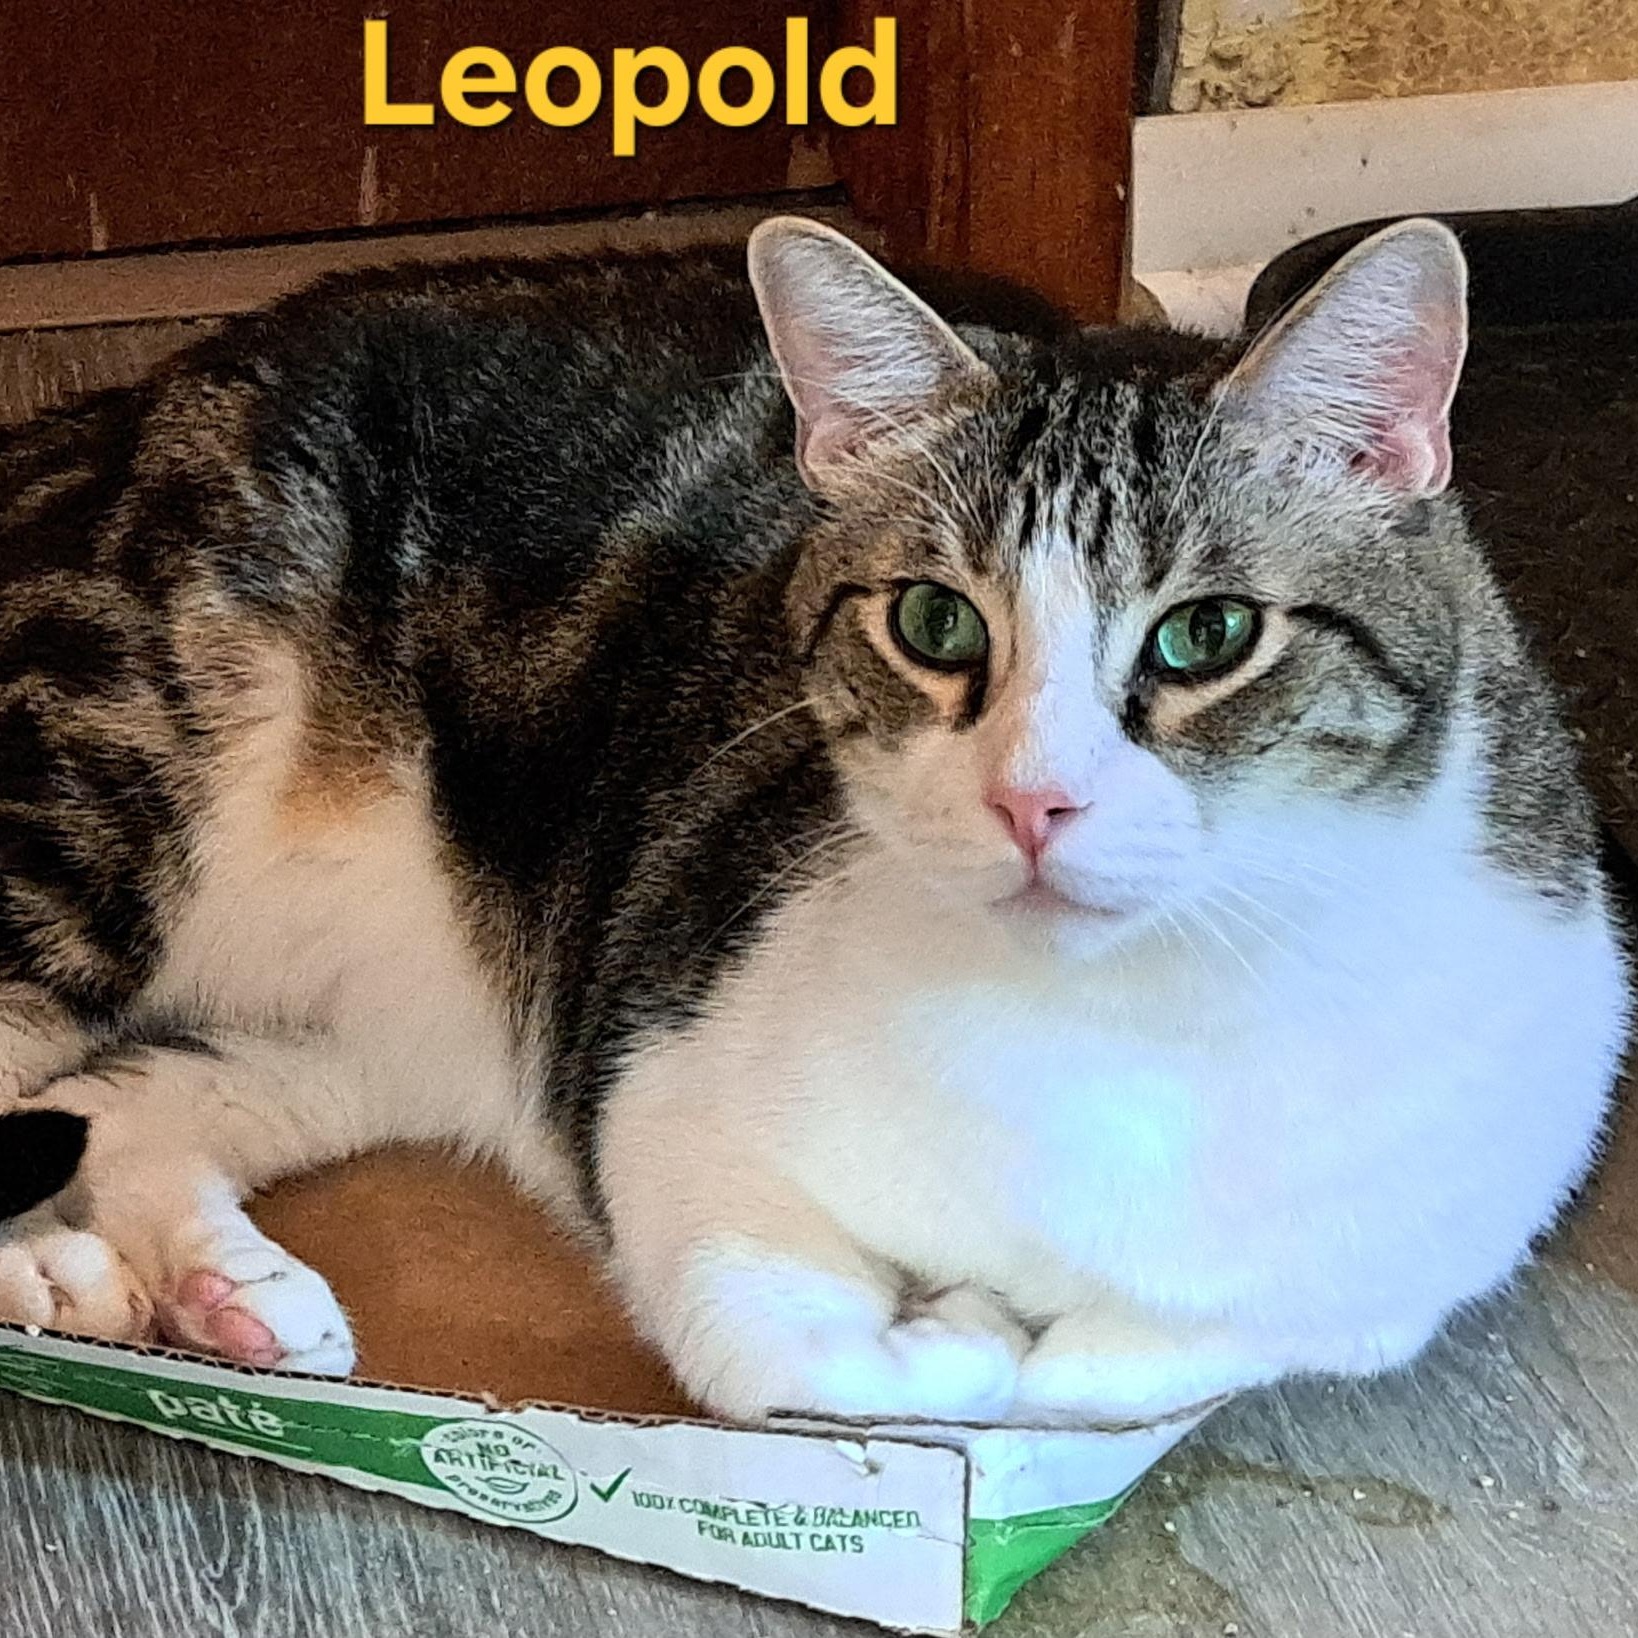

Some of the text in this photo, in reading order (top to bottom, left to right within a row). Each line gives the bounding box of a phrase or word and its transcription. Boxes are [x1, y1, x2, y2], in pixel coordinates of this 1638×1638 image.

[434, 1448, 565, 1481] ARTIFICIAL
[476, 1441, 511, 1457] NO
[679, 1498, 789, 1527] COMPLETE
[794, 1505, 807, 1526] &
[812, 1506, 921, 1528] BALANCED
[697, 1520, 864, 1553] FOR ADULT CATS
